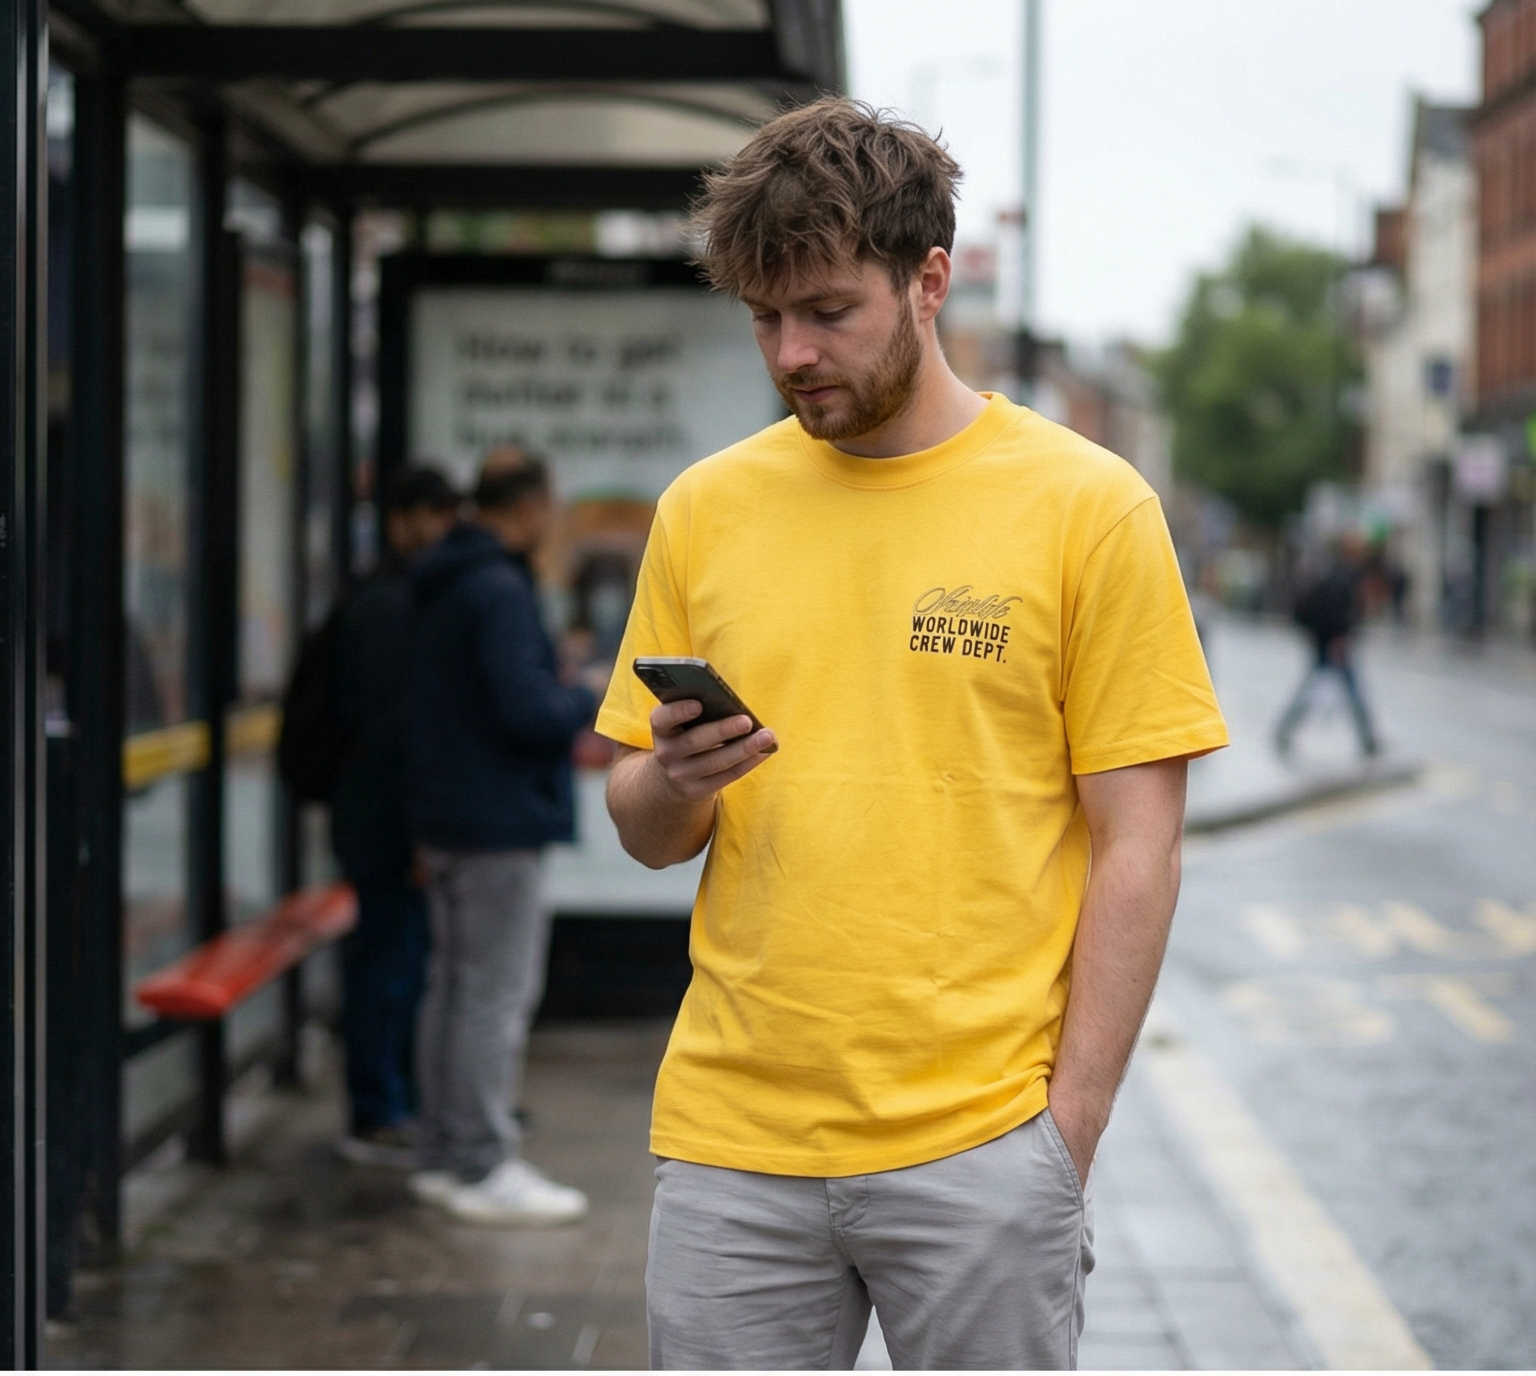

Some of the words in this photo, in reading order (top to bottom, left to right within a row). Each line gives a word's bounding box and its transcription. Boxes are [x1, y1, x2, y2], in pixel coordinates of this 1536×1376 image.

[912, 615, 1011, 644] WORLDWIDE
[909, 634, 956, 654] CREW
[961, 638, 1007, 664] DEPT.
